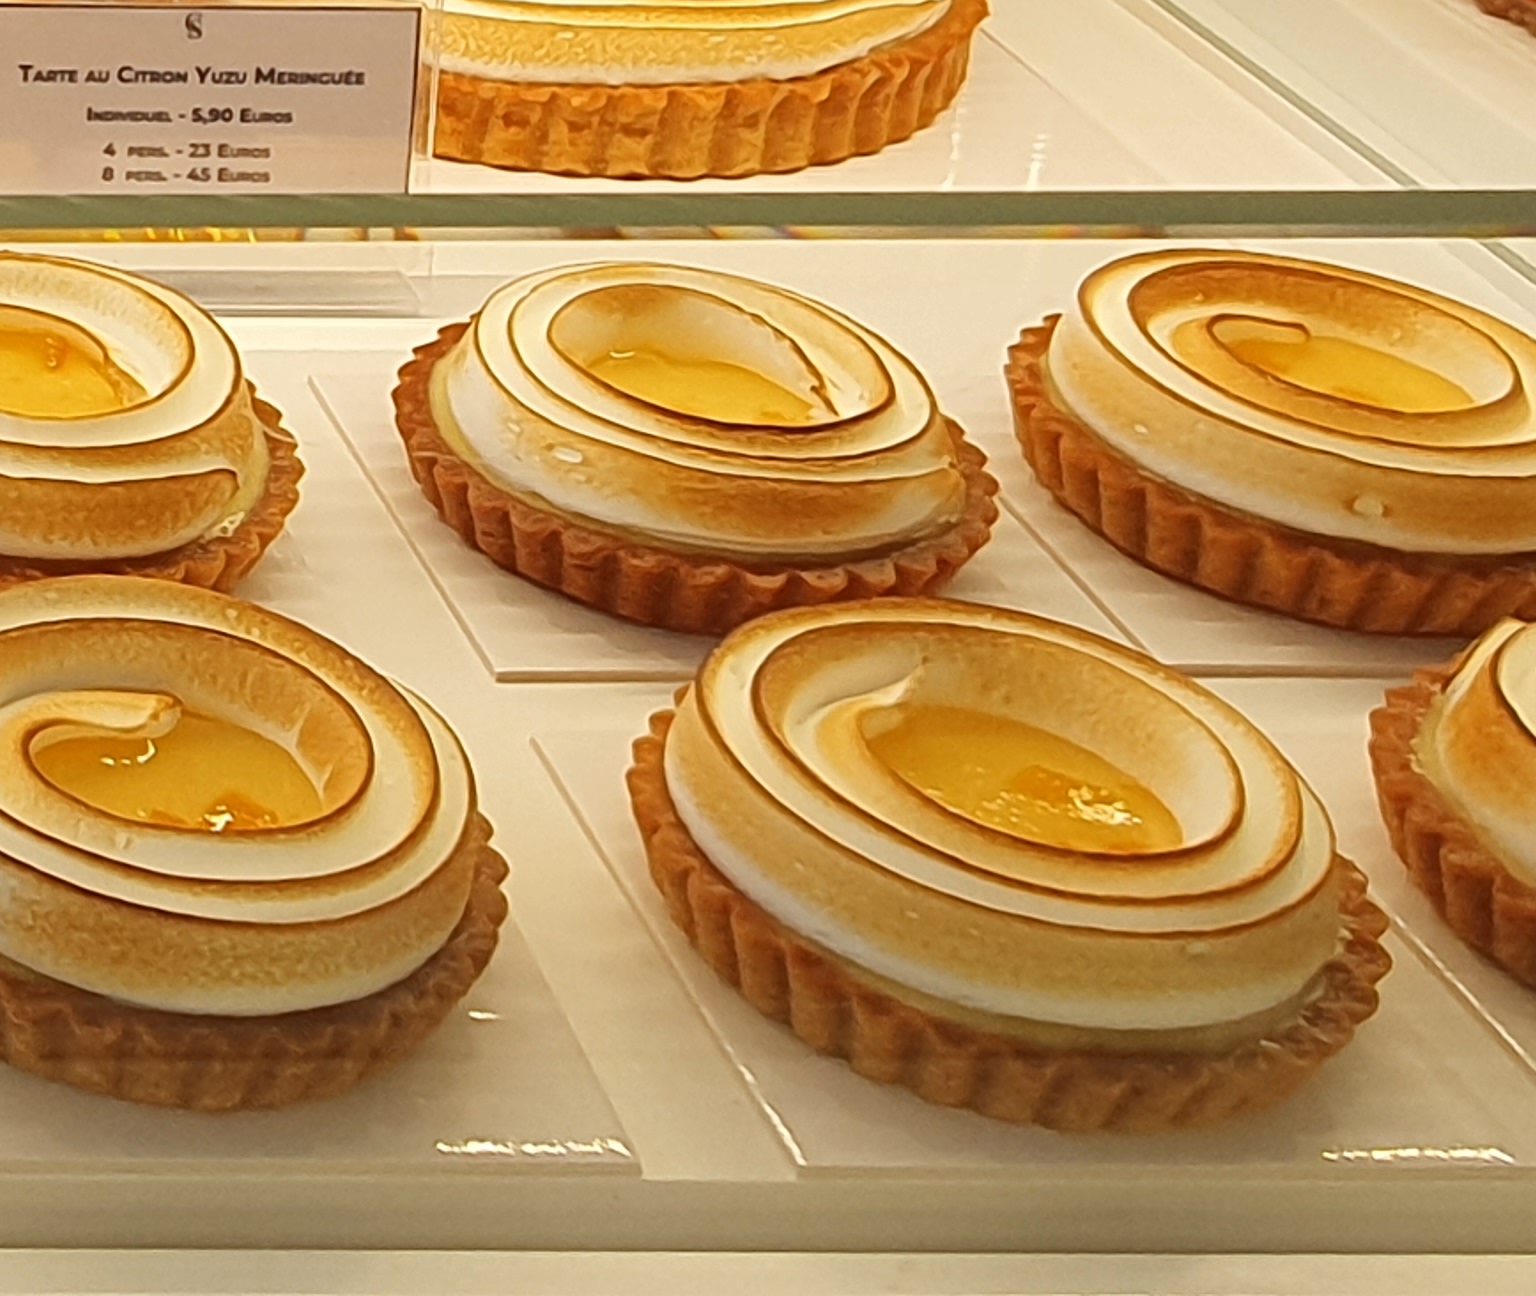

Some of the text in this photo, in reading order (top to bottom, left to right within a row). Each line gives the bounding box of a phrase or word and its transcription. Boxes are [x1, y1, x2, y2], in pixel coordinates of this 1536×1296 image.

[191, 107, 234, 124] 5,90
[102, 142, 117, 157] 4
[187, 142, 212, 158] 23
[101, 165, 115, 182] 8
[185, 166, 212, 182] 45
